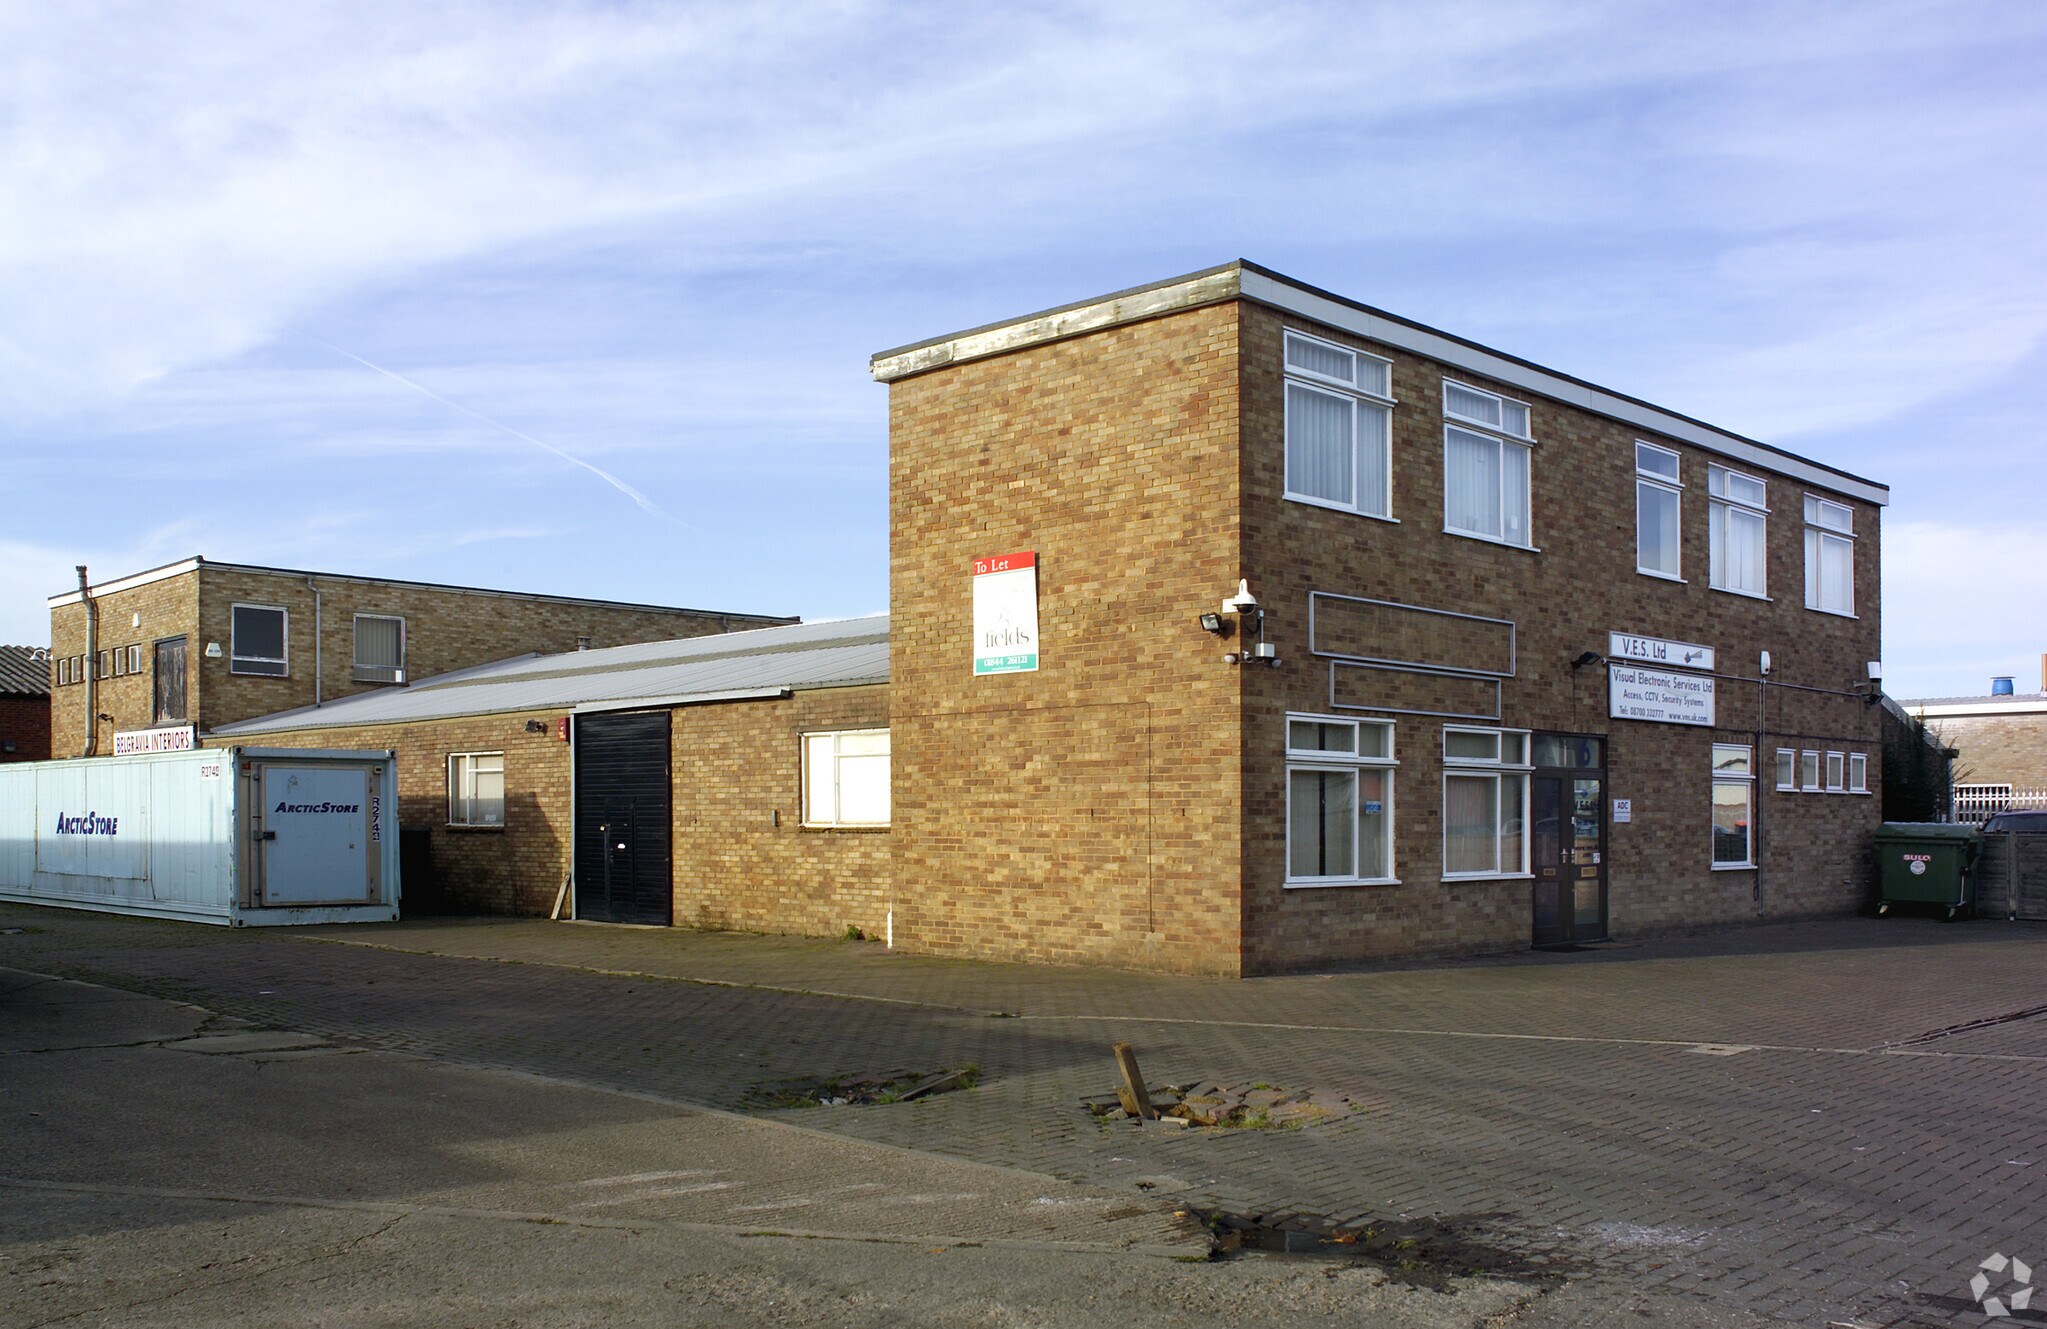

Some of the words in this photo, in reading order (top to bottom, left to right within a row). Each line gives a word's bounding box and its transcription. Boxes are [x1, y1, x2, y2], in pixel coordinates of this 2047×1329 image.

[975, 561, 987, 574] To
[991, 559, 1009, 571] Let
[1622, 638, 1649, 657] V.E.S.
[1653, 643, 1667, 660] Ltd
[1613, 669, 1636, 684] Visual
[1638, 672, 1671, 688] Electronic
[1673, 676, 1701, 692] Services
[1703, 681, 1713, 693] Ltd
[1623, 689, 1643, 701] Access,
[1662, 693, 1683, 707] Security
[1684, 695, 1705, 708] Systems
[116, 734, 150, 754] BELGRAVIA
[151, 731, 190, 751] INTERIORS
[1617, 801, 1628, 810] ADC
